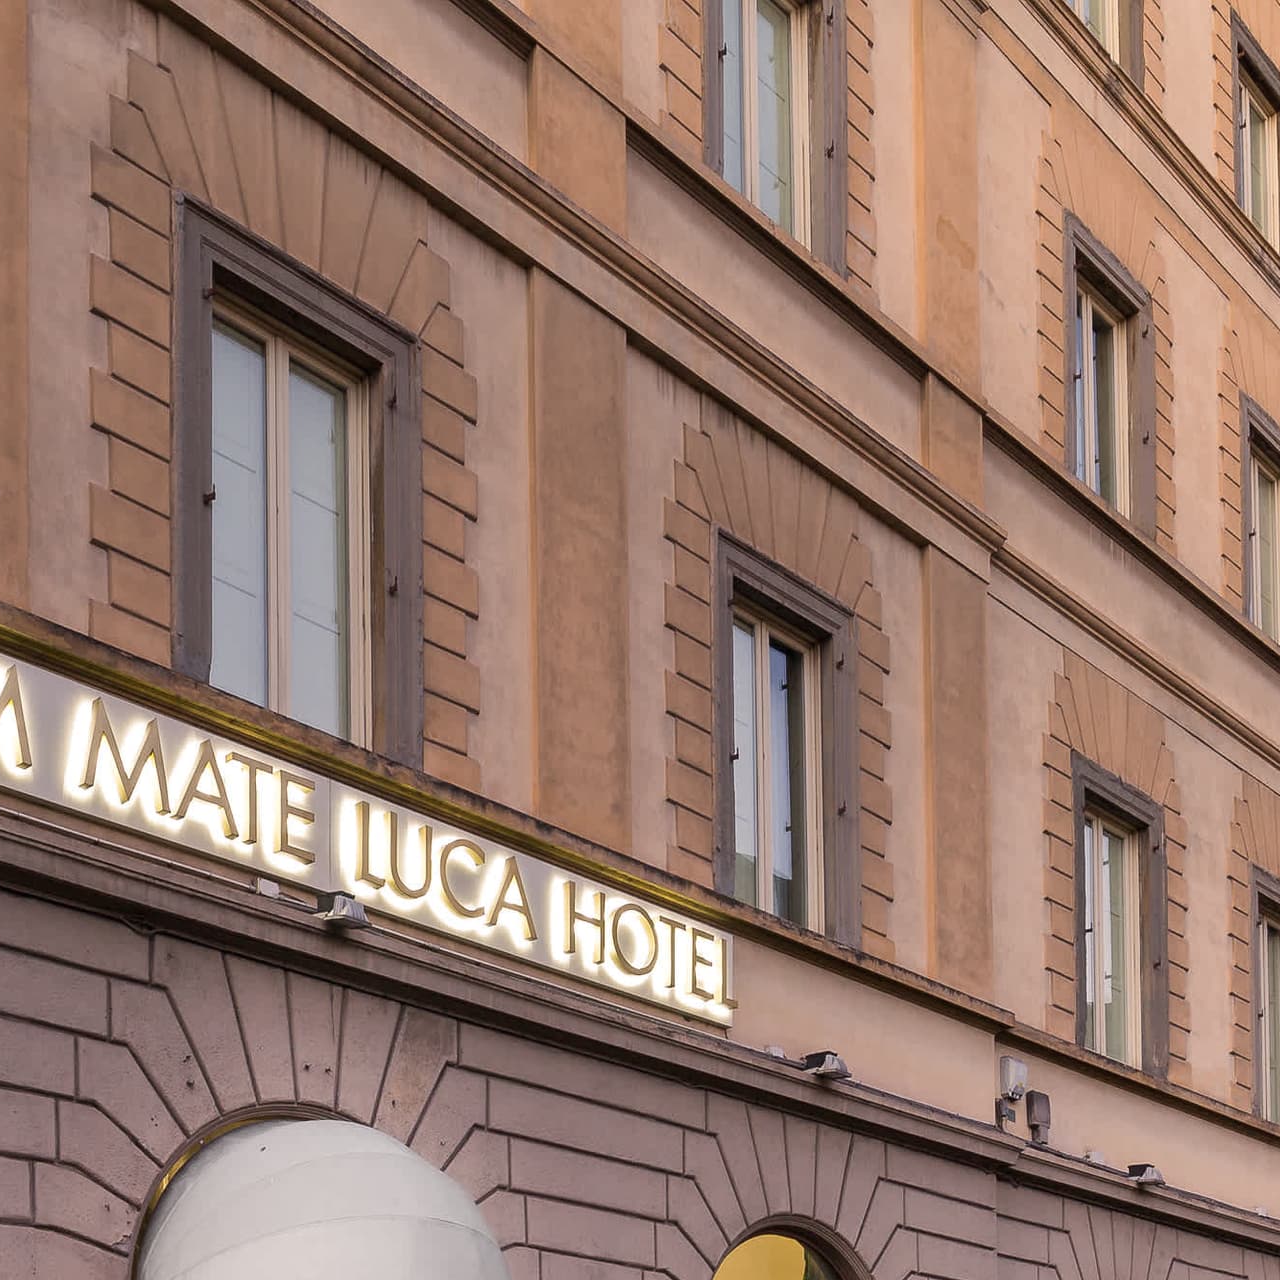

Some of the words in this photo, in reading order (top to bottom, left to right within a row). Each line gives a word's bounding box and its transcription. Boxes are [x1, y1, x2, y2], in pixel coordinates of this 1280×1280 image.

[78, 696, 316, 866] MATE
[354, 800, 537, 942] LUCA
[563, 880, 738, 1010] HOTEL
